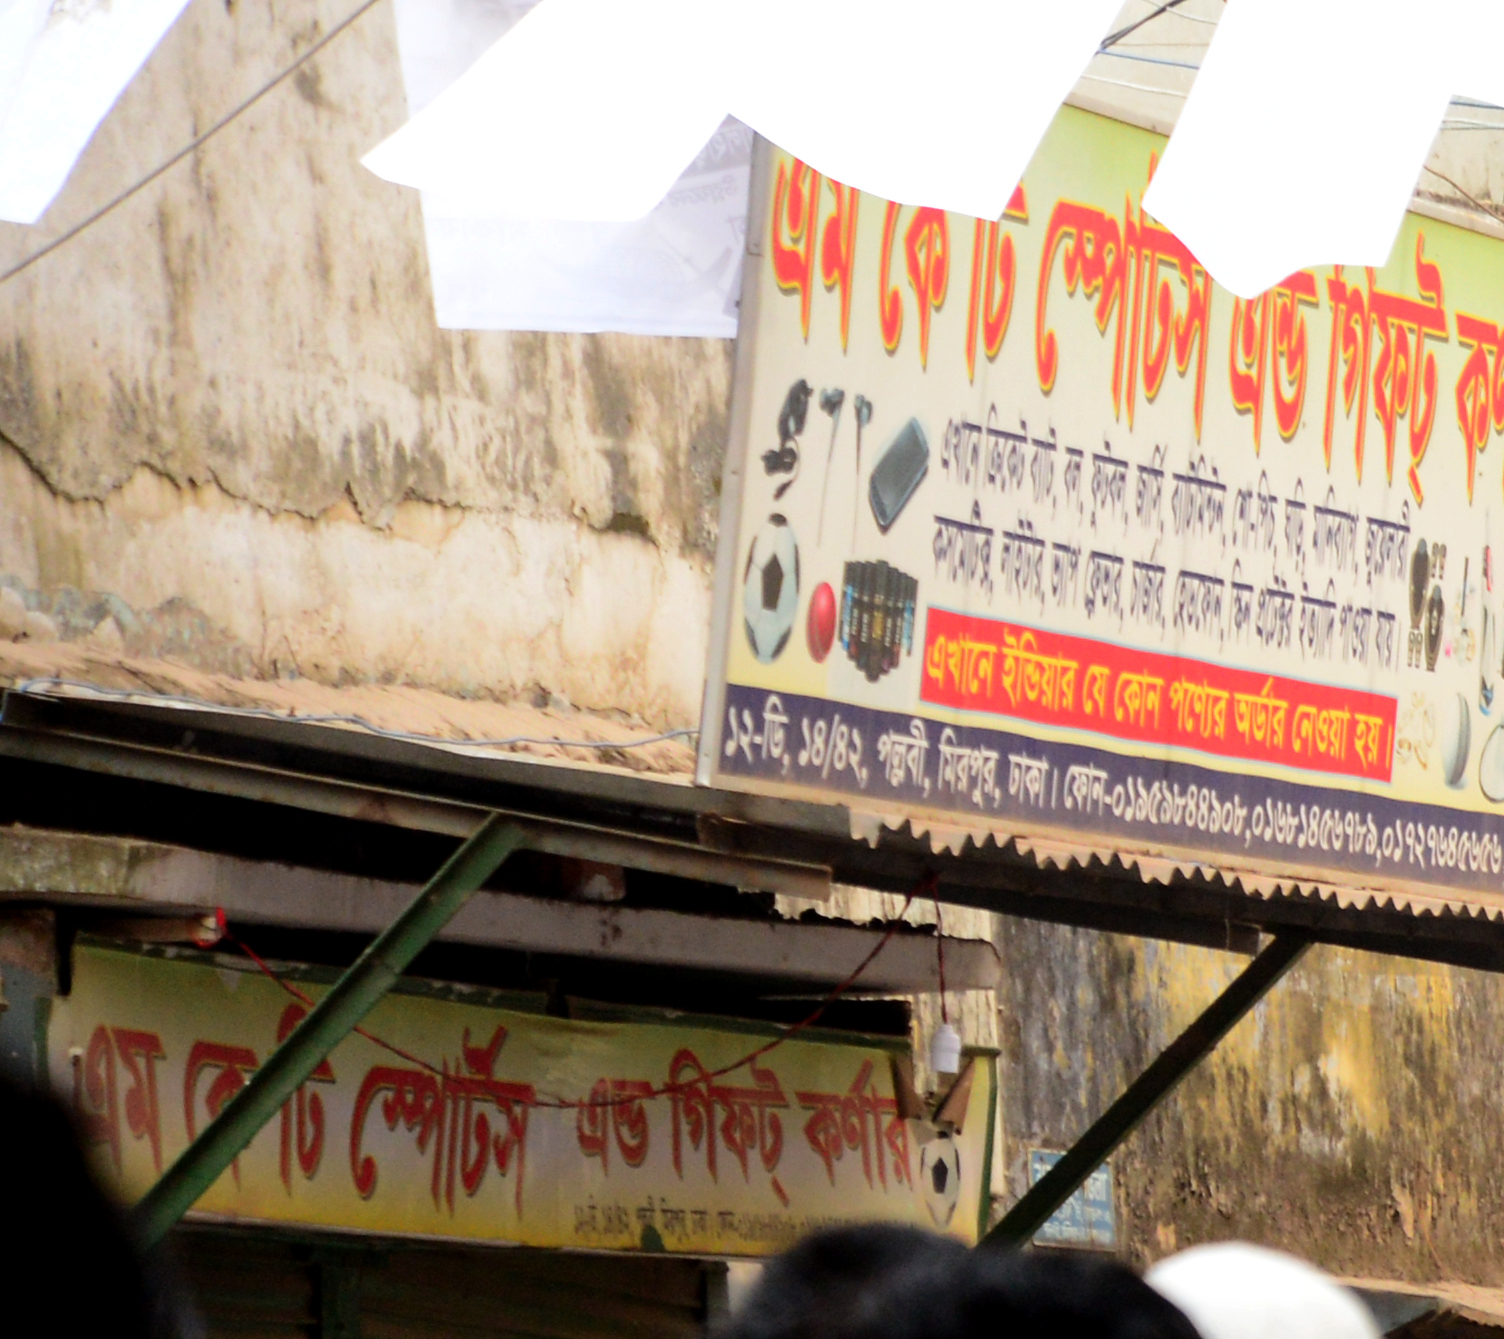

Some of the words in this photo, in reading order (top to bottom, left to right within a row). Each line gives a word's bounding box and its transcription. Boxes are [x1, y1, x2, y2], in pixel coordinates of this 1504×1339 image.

[772, 158, 859, 355] এম
[879, 200, 949, 371] কে
[799, 713, 869, 789] ১৪/৪২,
[877, 718, 930, 799] পল্লবী,
[938, 728, 1000, 809] মিরপুর,
[926, 634, 997, 697] এখানে
[1001, 627, 1079, 713] ইন্ডিয়ার
[1083, 661, 1110, 727] যে
[1114, 669, 1163, 730] কোন
[1168, 675, 1230, 743] পণ্যের
[1233, 675, 1288, 751] অর্ডার
[1292, 702, 1351, 758] নেওয়া
[85, 1023, 167, 1176] এম
[350, 1024, 537, 1222] স্পোর্টস
[576, 1077, 656, 1179] এন্ড
[794, 1057, 915, 1193] কর্ণার
